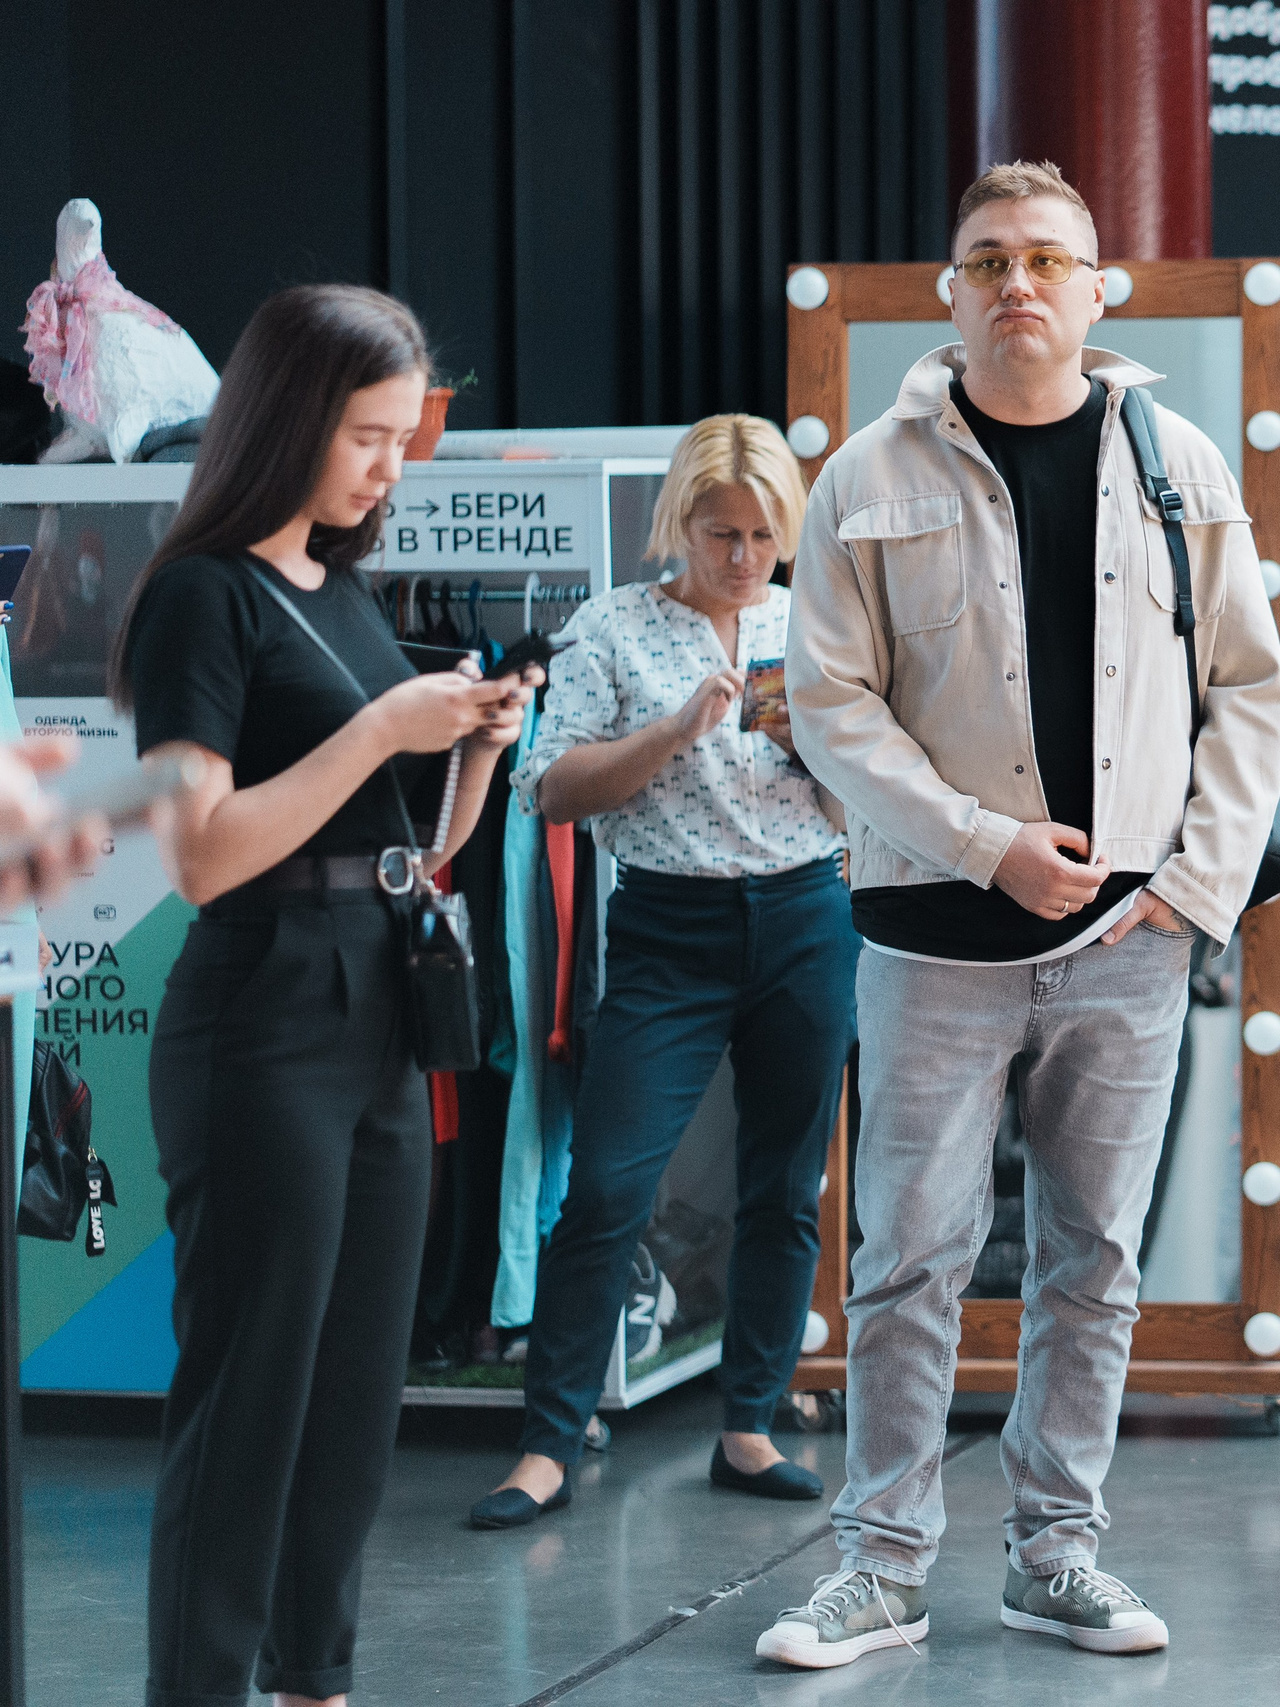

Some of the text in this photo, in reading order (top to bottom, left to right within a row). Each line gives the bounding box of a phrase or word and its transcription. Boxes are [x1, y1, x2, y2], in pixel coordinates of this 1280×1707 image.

[451, 492, 546, 519] БЕРИ
[398, 526, 419, 553] В
[429, 526, 574, 559] ТРЕНДЕ
[34, 715, 87, 726] ОДЕЖДА
[76, 727, 119, 739] ЖИЗНЬ
[47, 941, 119, 967] УРА
[90, 1206, 105, 1249] LOVE
